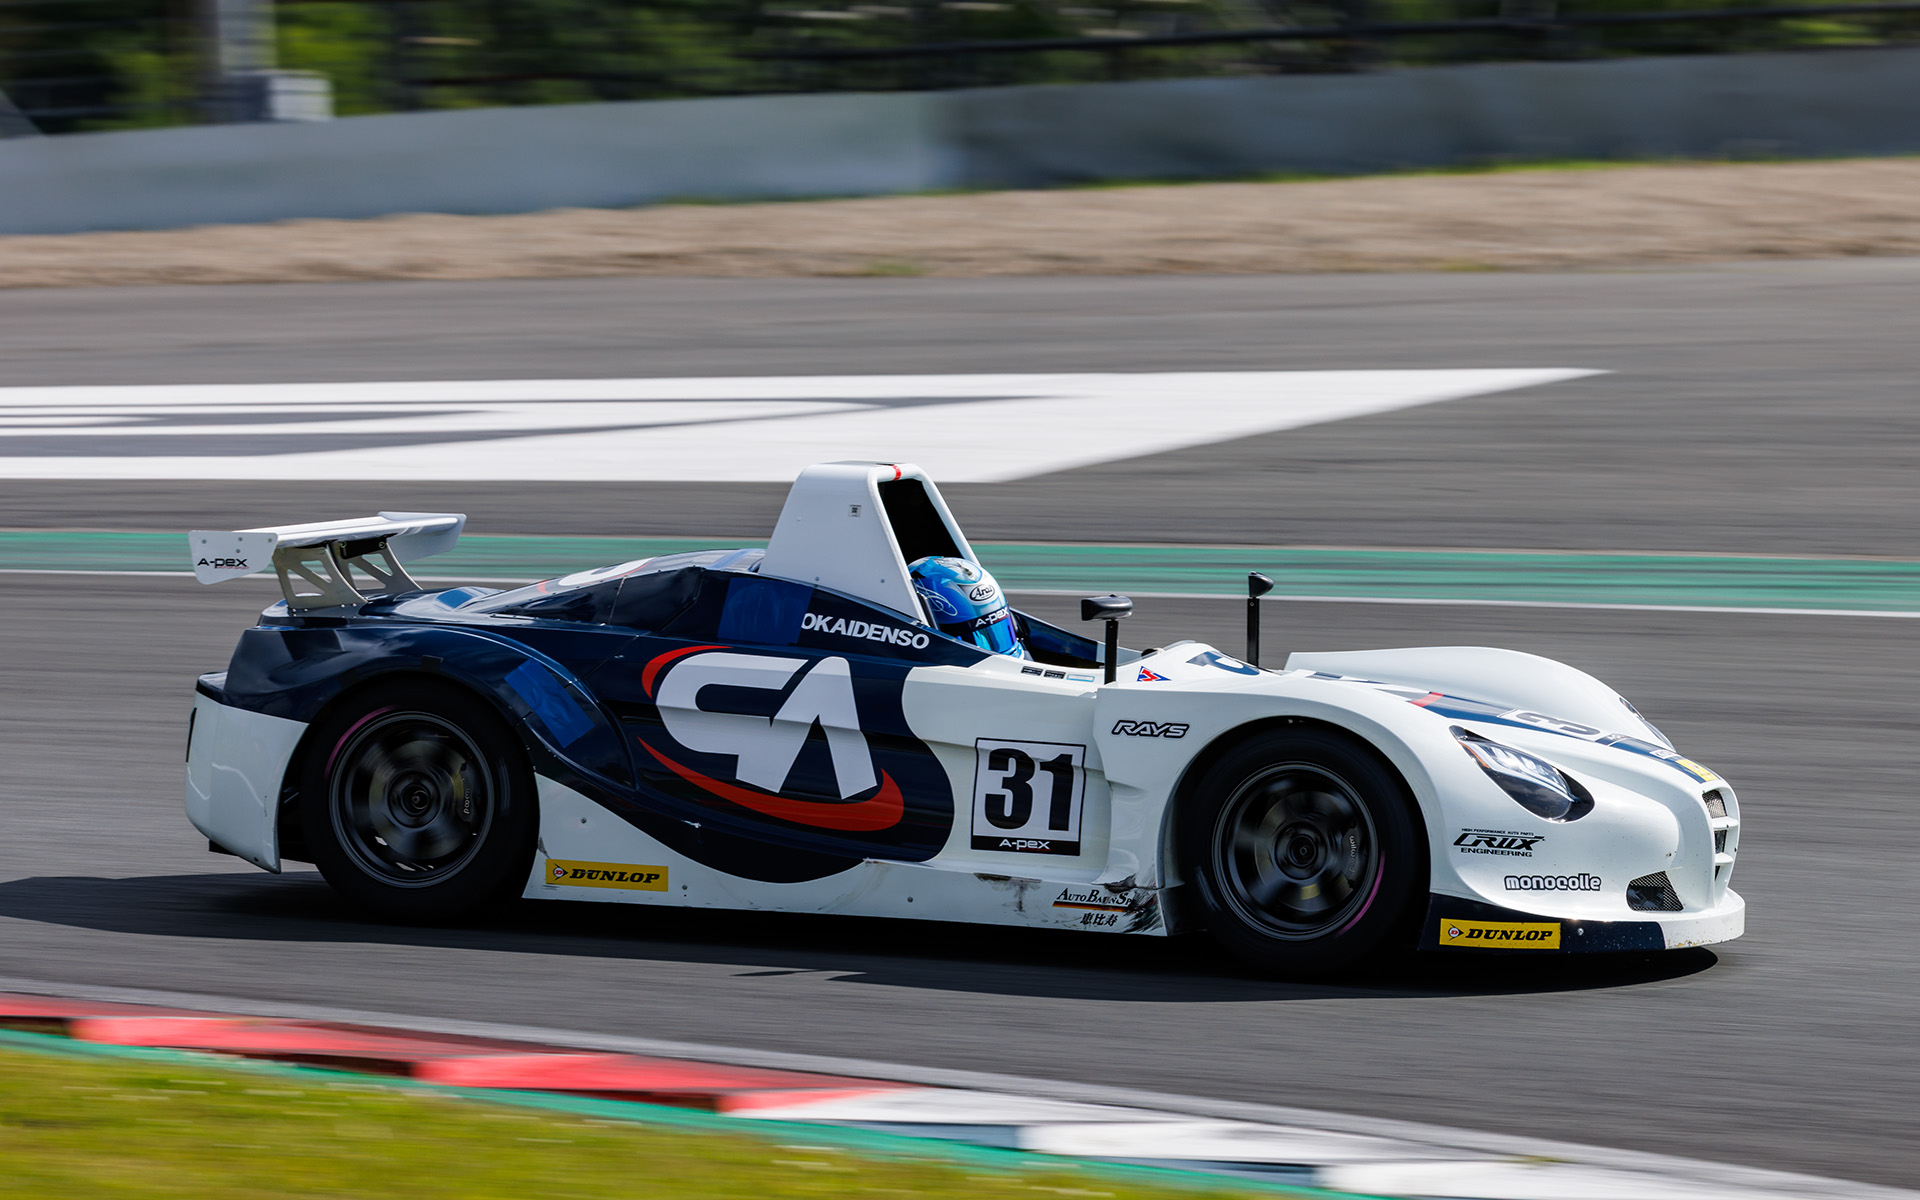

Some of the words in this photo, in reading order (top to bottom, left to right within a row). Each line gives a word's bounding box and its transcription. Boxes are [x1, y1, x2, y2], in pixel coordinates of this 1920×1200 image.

[197, 558, 248, 569] A-pex
[975, 606, 1010, 628] A-pex
[1111, 720, 1190, 738] RAYS
[985, 748, 1074, 831] 31
[999, 839, 1051, 850] A-pex
[1460, 848, 1532, 858] ENGINEERING
[569, 869, 661, 884] DUNLOP
[1504, 873, 1602, 891] monocolle
[1465, 928, 1553, 941] DUNLOP
